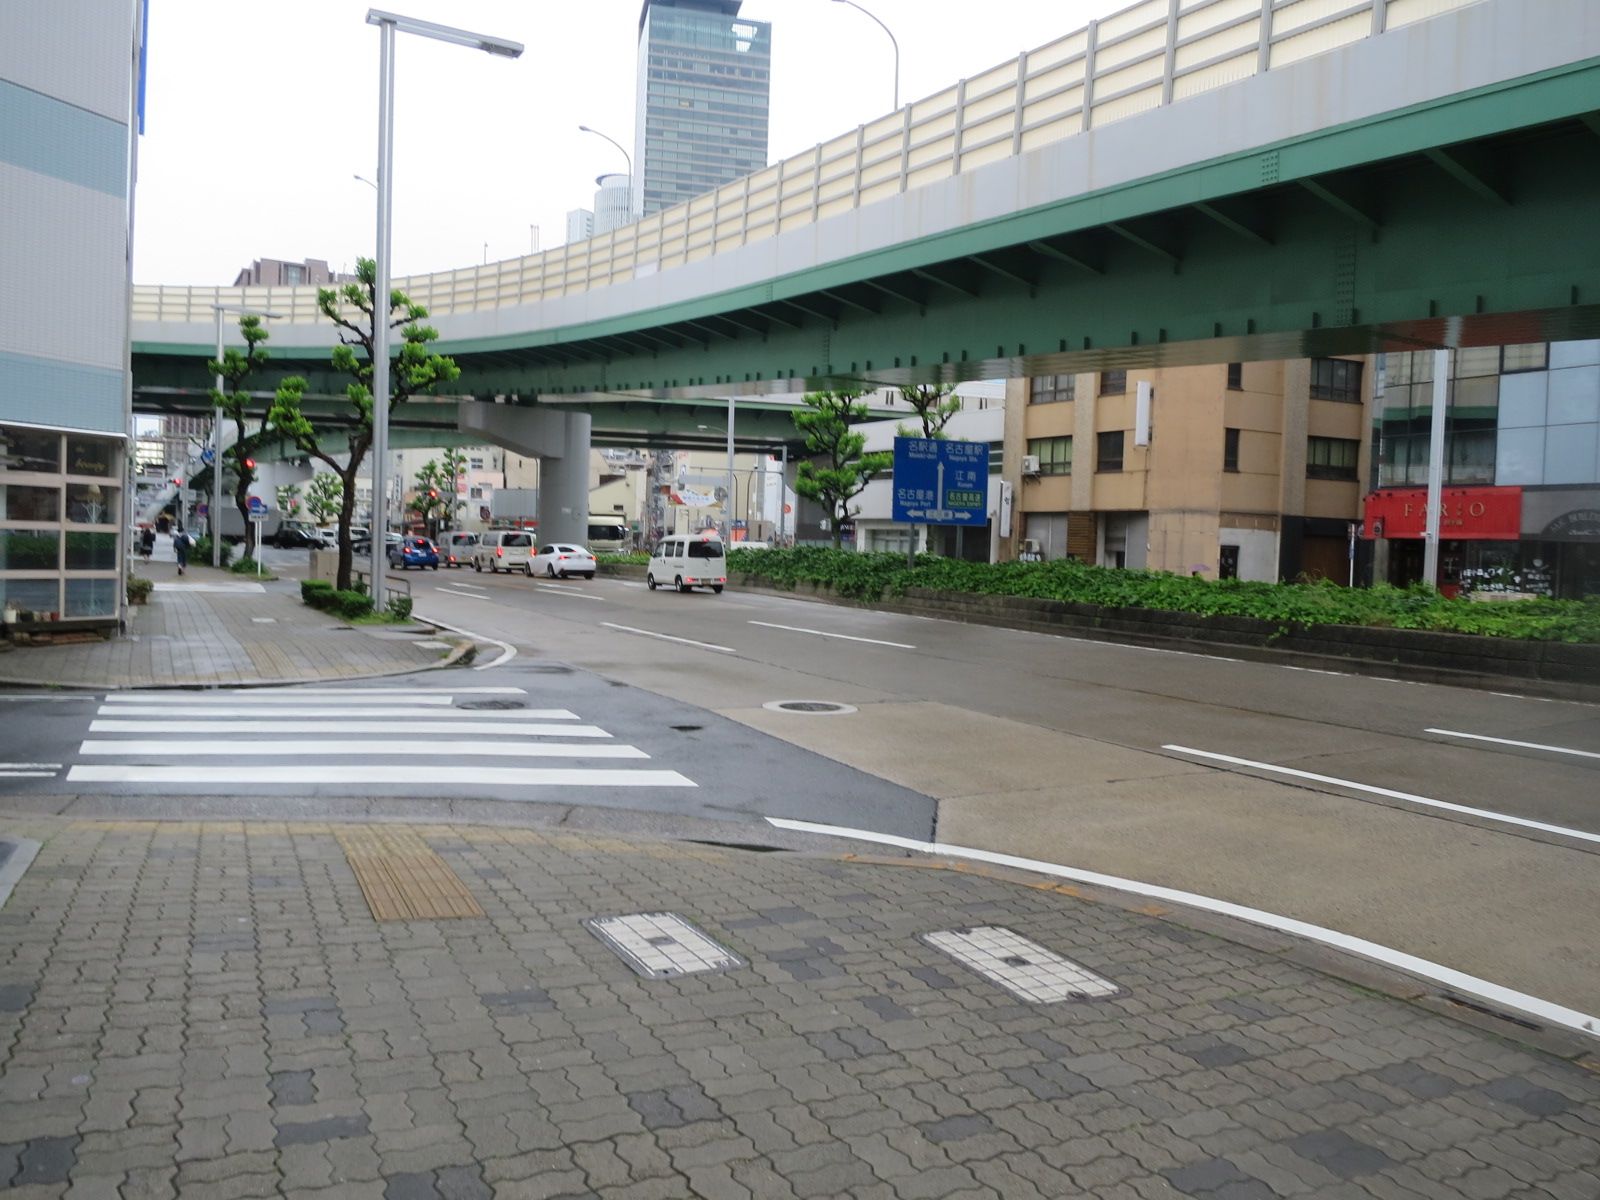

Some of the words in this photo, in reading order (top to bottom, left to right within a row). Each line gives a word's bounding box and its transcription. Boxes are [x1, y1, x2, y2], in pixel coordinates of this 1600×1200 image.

[945, 443, 983, 455] 名古屋駅
[898, 488, 934, 500] 名古屋港
[949, 492, 981, 501] 名古屋高速
